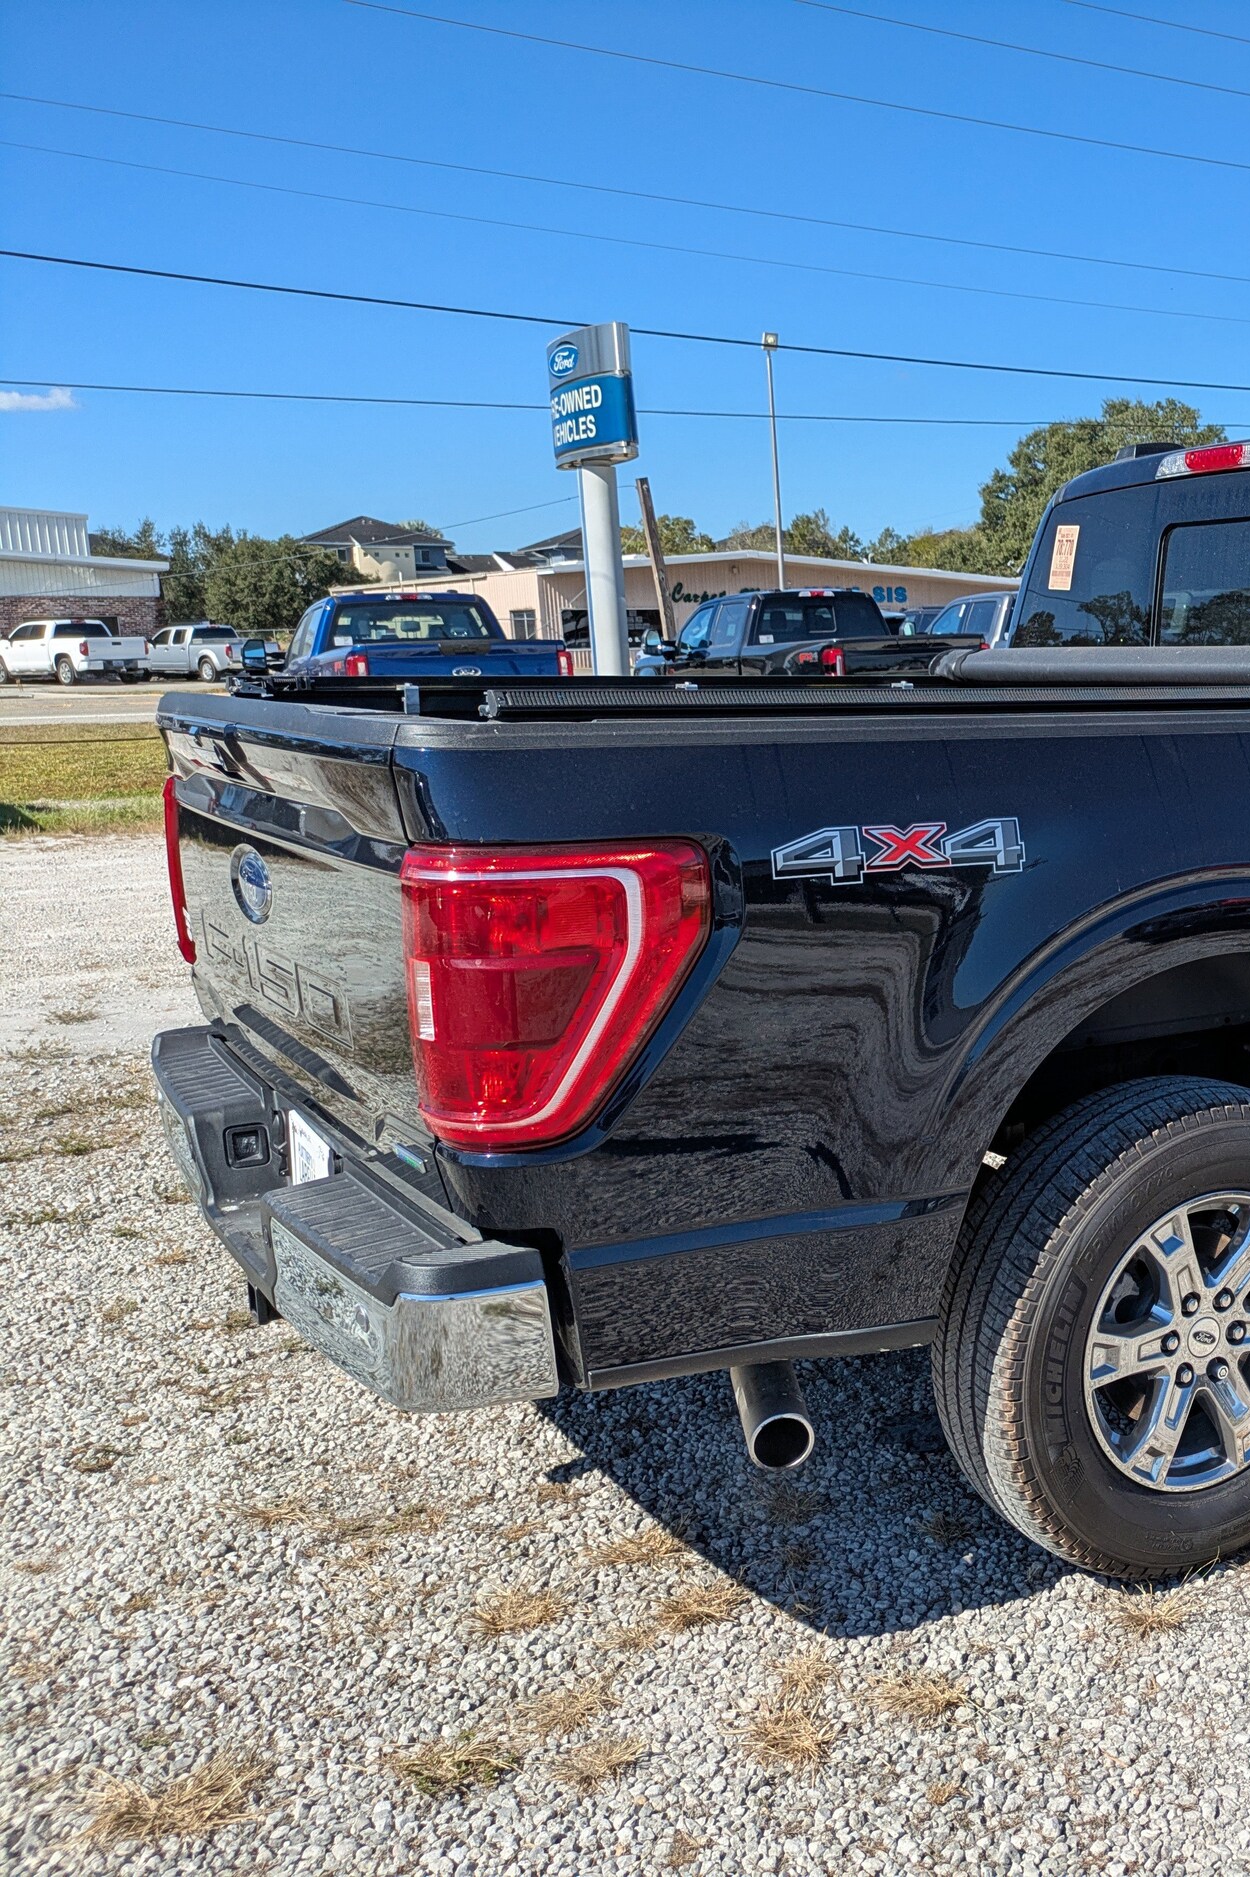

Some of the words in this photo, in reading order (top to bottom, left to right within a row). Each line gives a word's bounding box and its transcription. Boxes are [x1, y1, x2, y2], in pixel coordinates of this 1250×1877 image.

[554, 351, 575, 371] Ford
[771, 818, 1025, 886] 4X4
[1046, 1280, 1082, 1443] MICHELIN
